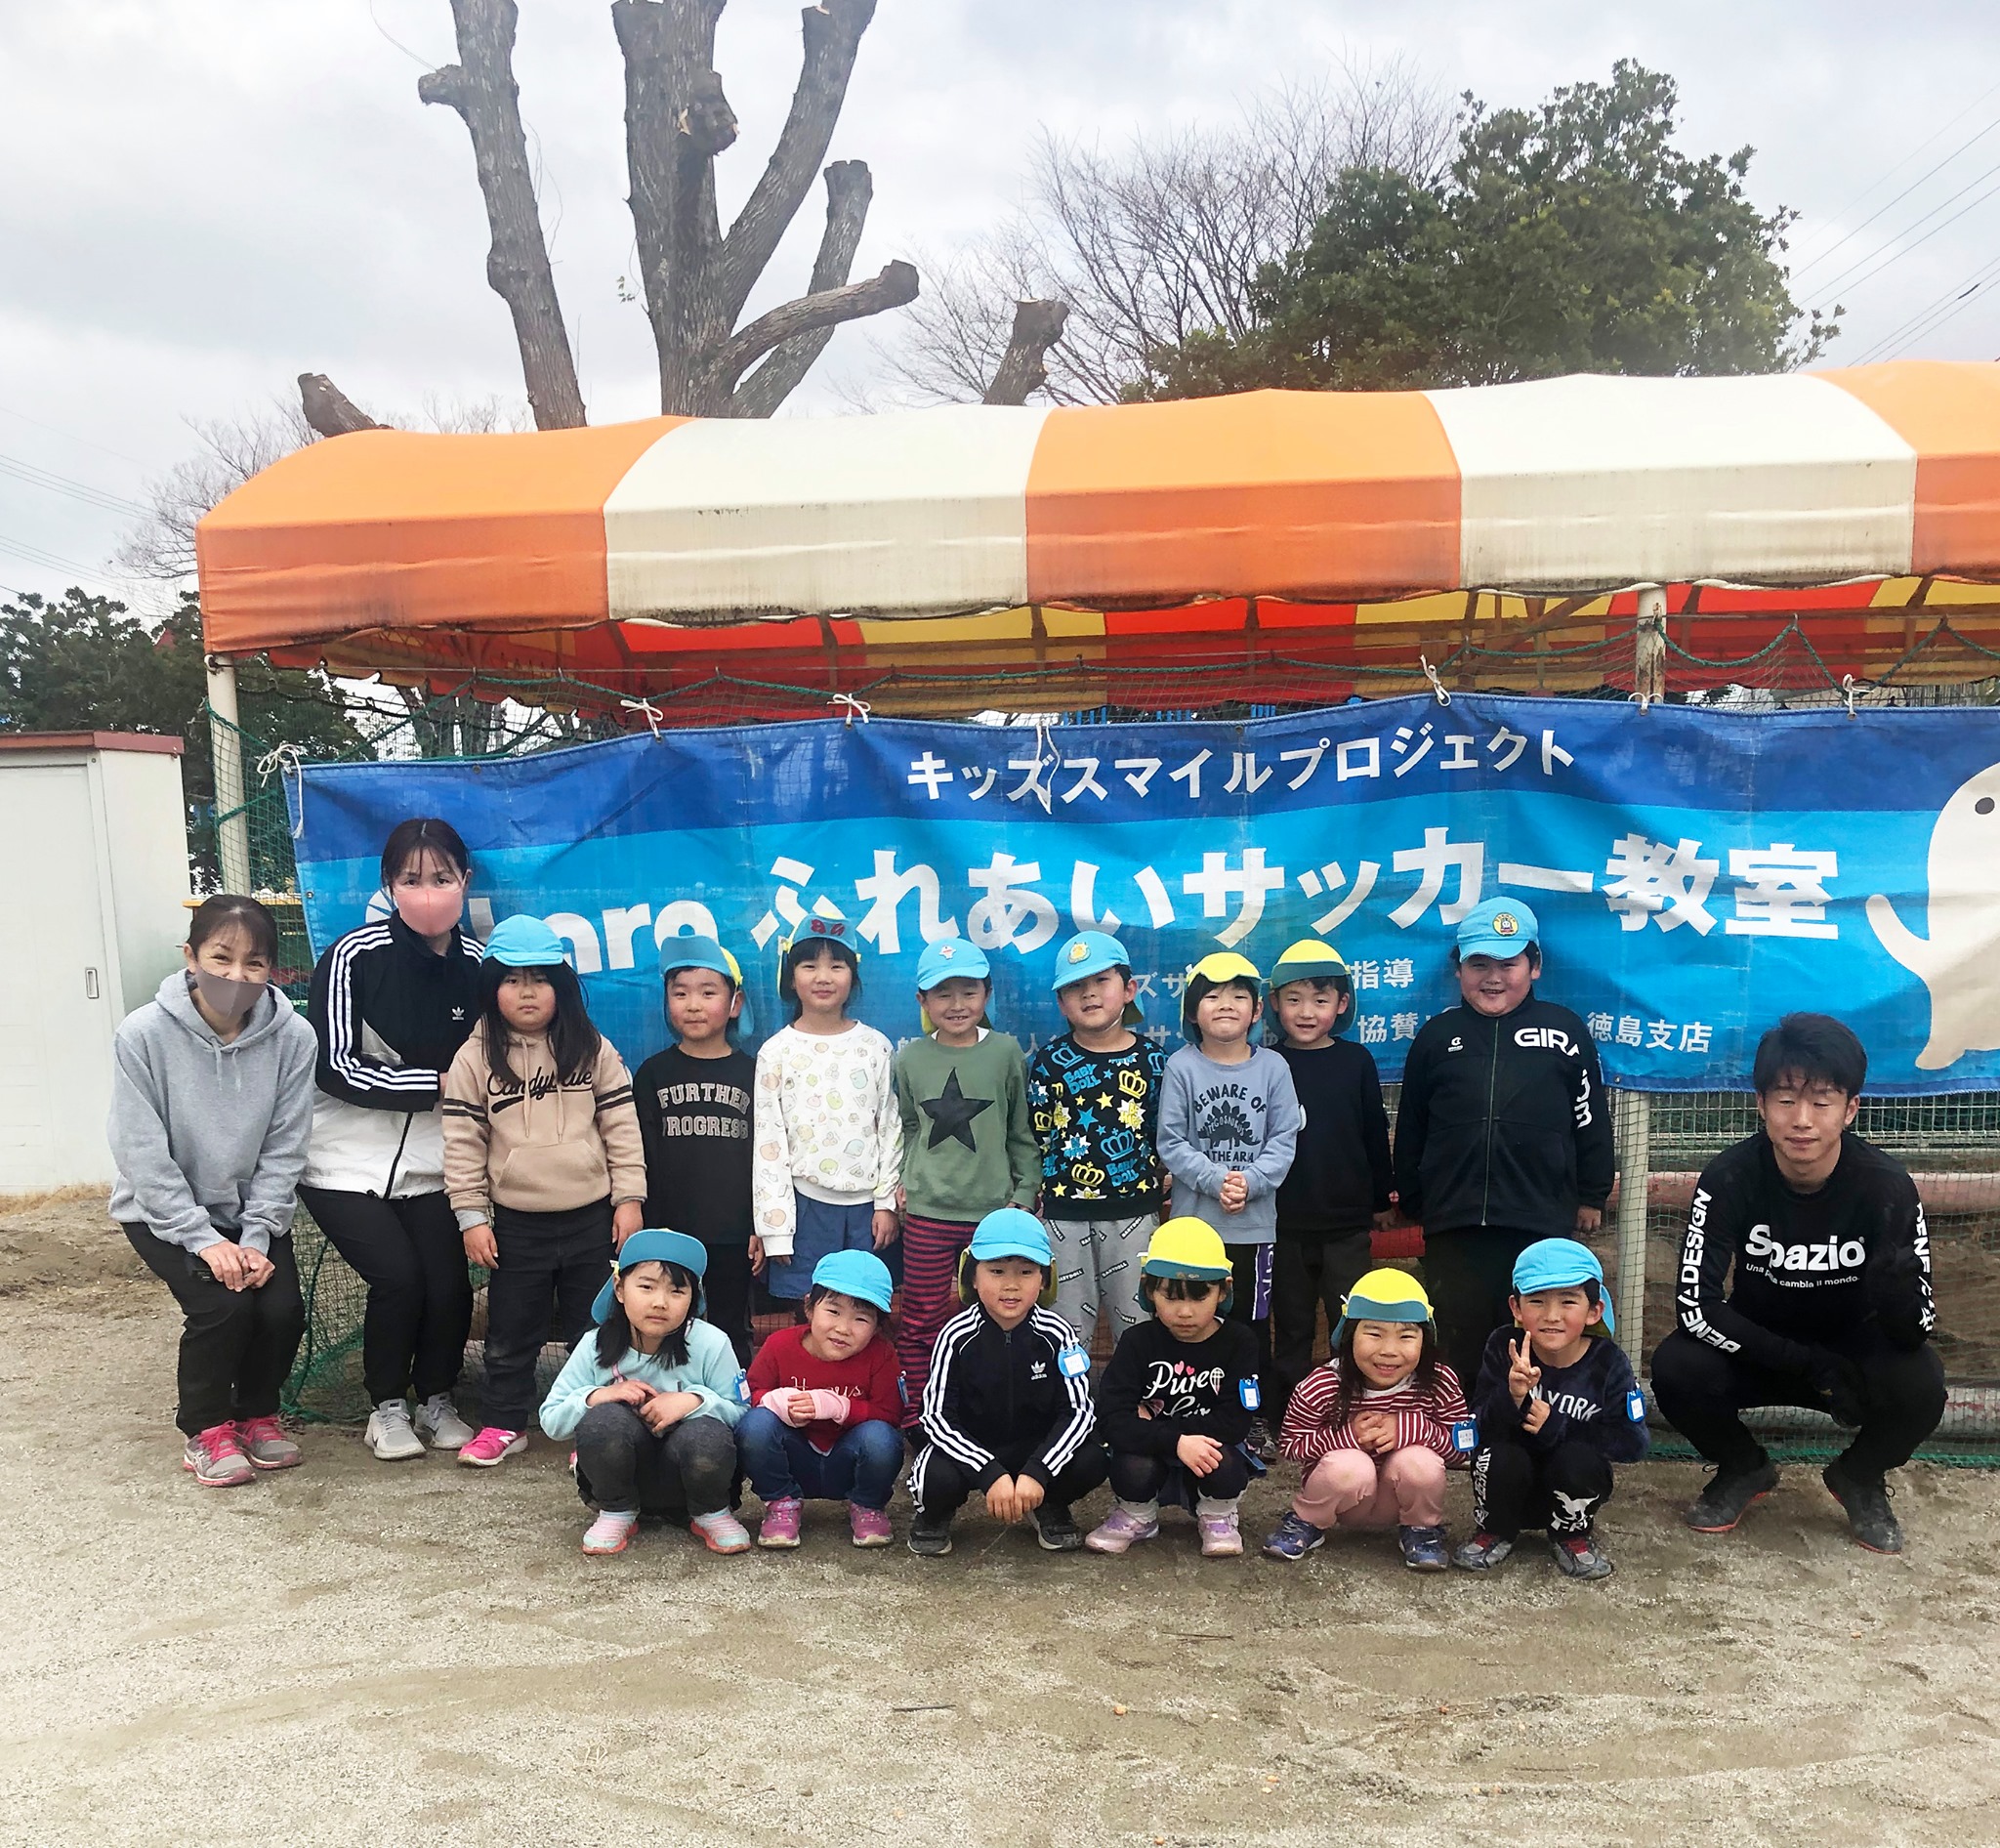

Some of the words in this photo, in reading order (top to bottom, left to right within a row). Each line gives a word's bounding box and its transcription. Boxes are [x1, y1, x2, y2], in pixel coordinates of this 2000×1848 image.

[907, 722, 1574, 804] キッズスマイルプロジェクト
[751, 826, 1839, 954] ふれあいサッカー教室
[1587, 1011, 1713, 1054] 徳島支店
[1062, 1064, 1098, 1083] BABY
[1068, 1074, 1102, 1095] DOLL
[657, 1083, 750, 1114] FURTHER
[1193, 1083, 1248, 1113] BEWARE
[1250, 1096, 1268, 1113] OF
[662, 1115, 749, 1140] ROGRESS
[1212, 1151, 1231, 1162] THE
[1745, 1224, 1865, 1271] Spazio
[1143, 1361, 1210, 1400] Pure
[1547, 1389, 1603, 1422] YORK
